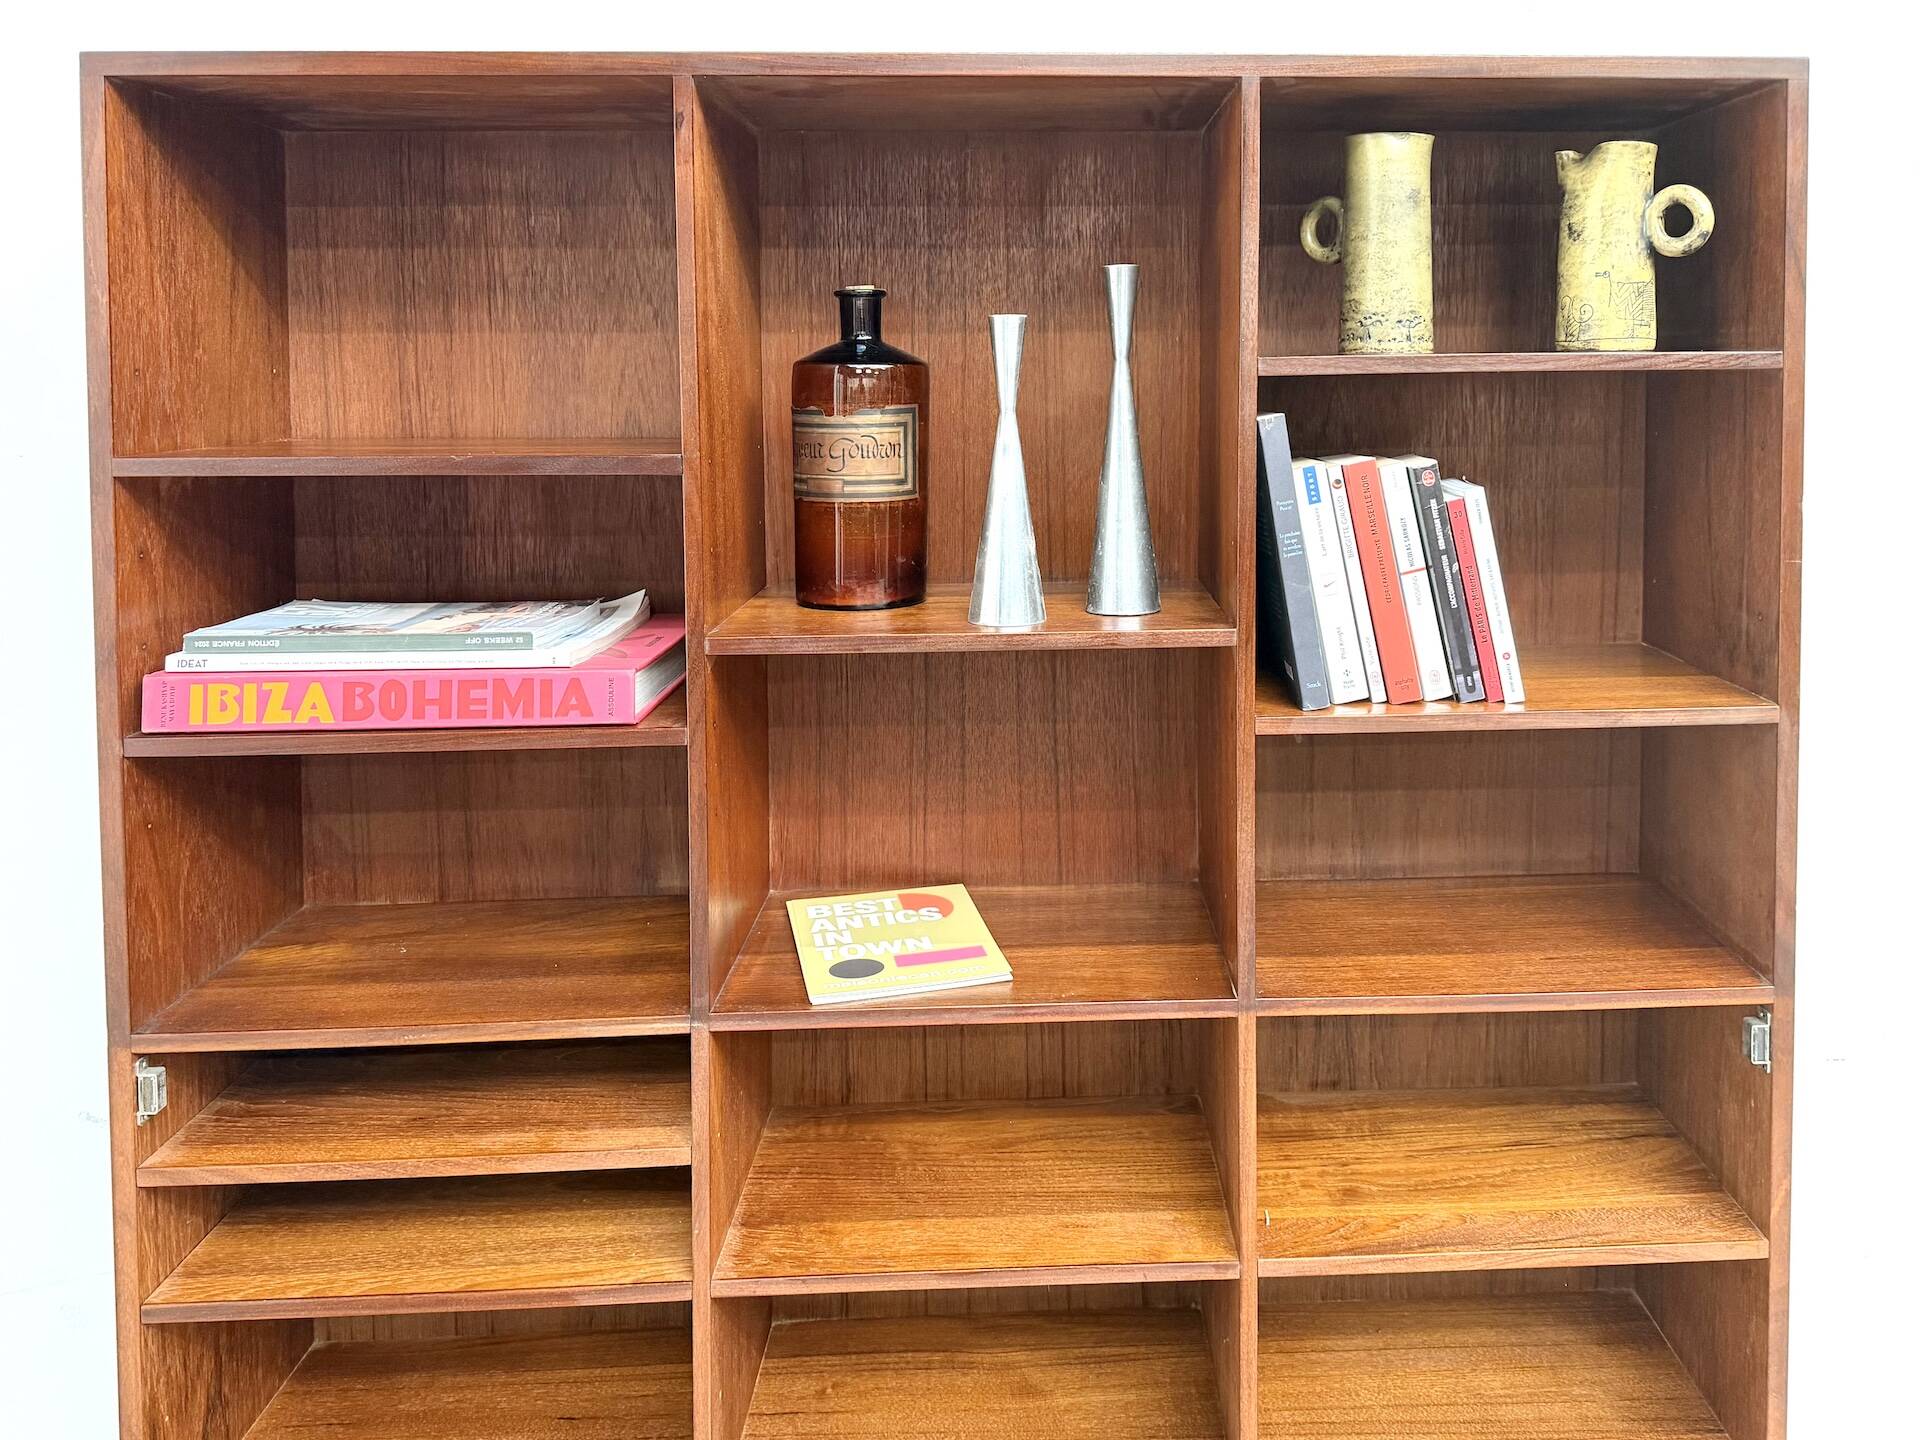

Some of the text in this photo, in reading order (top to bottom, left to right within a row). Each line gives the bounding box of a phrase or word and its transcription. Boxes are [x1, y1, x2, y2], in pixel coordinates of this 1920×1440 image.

[1307, 472, 1319, 501] SPORT
[1360, 474, 1371, 494] NOIR
[1364, 495, 1379, 536] MARSEILLE
[1465, 566, 1479, 601] Mitterrand
[1476, 613, 1485, 633] PARIS
[212, 640, 245, 648] FRANCE
[465, 637, 482, 645] OFF
[177, 659, 208, 669] IDEAT
[188, 678, 594, 725] IBIZA BOHEMIA
[607, 677, 615, 717] ASSOULINE
[806, 896, 898, 919] BEST
[810, 906, 944, 933] ANTICS
[812, 930, 853, 947] IN
[815, 936, 934, 961] TOWN
